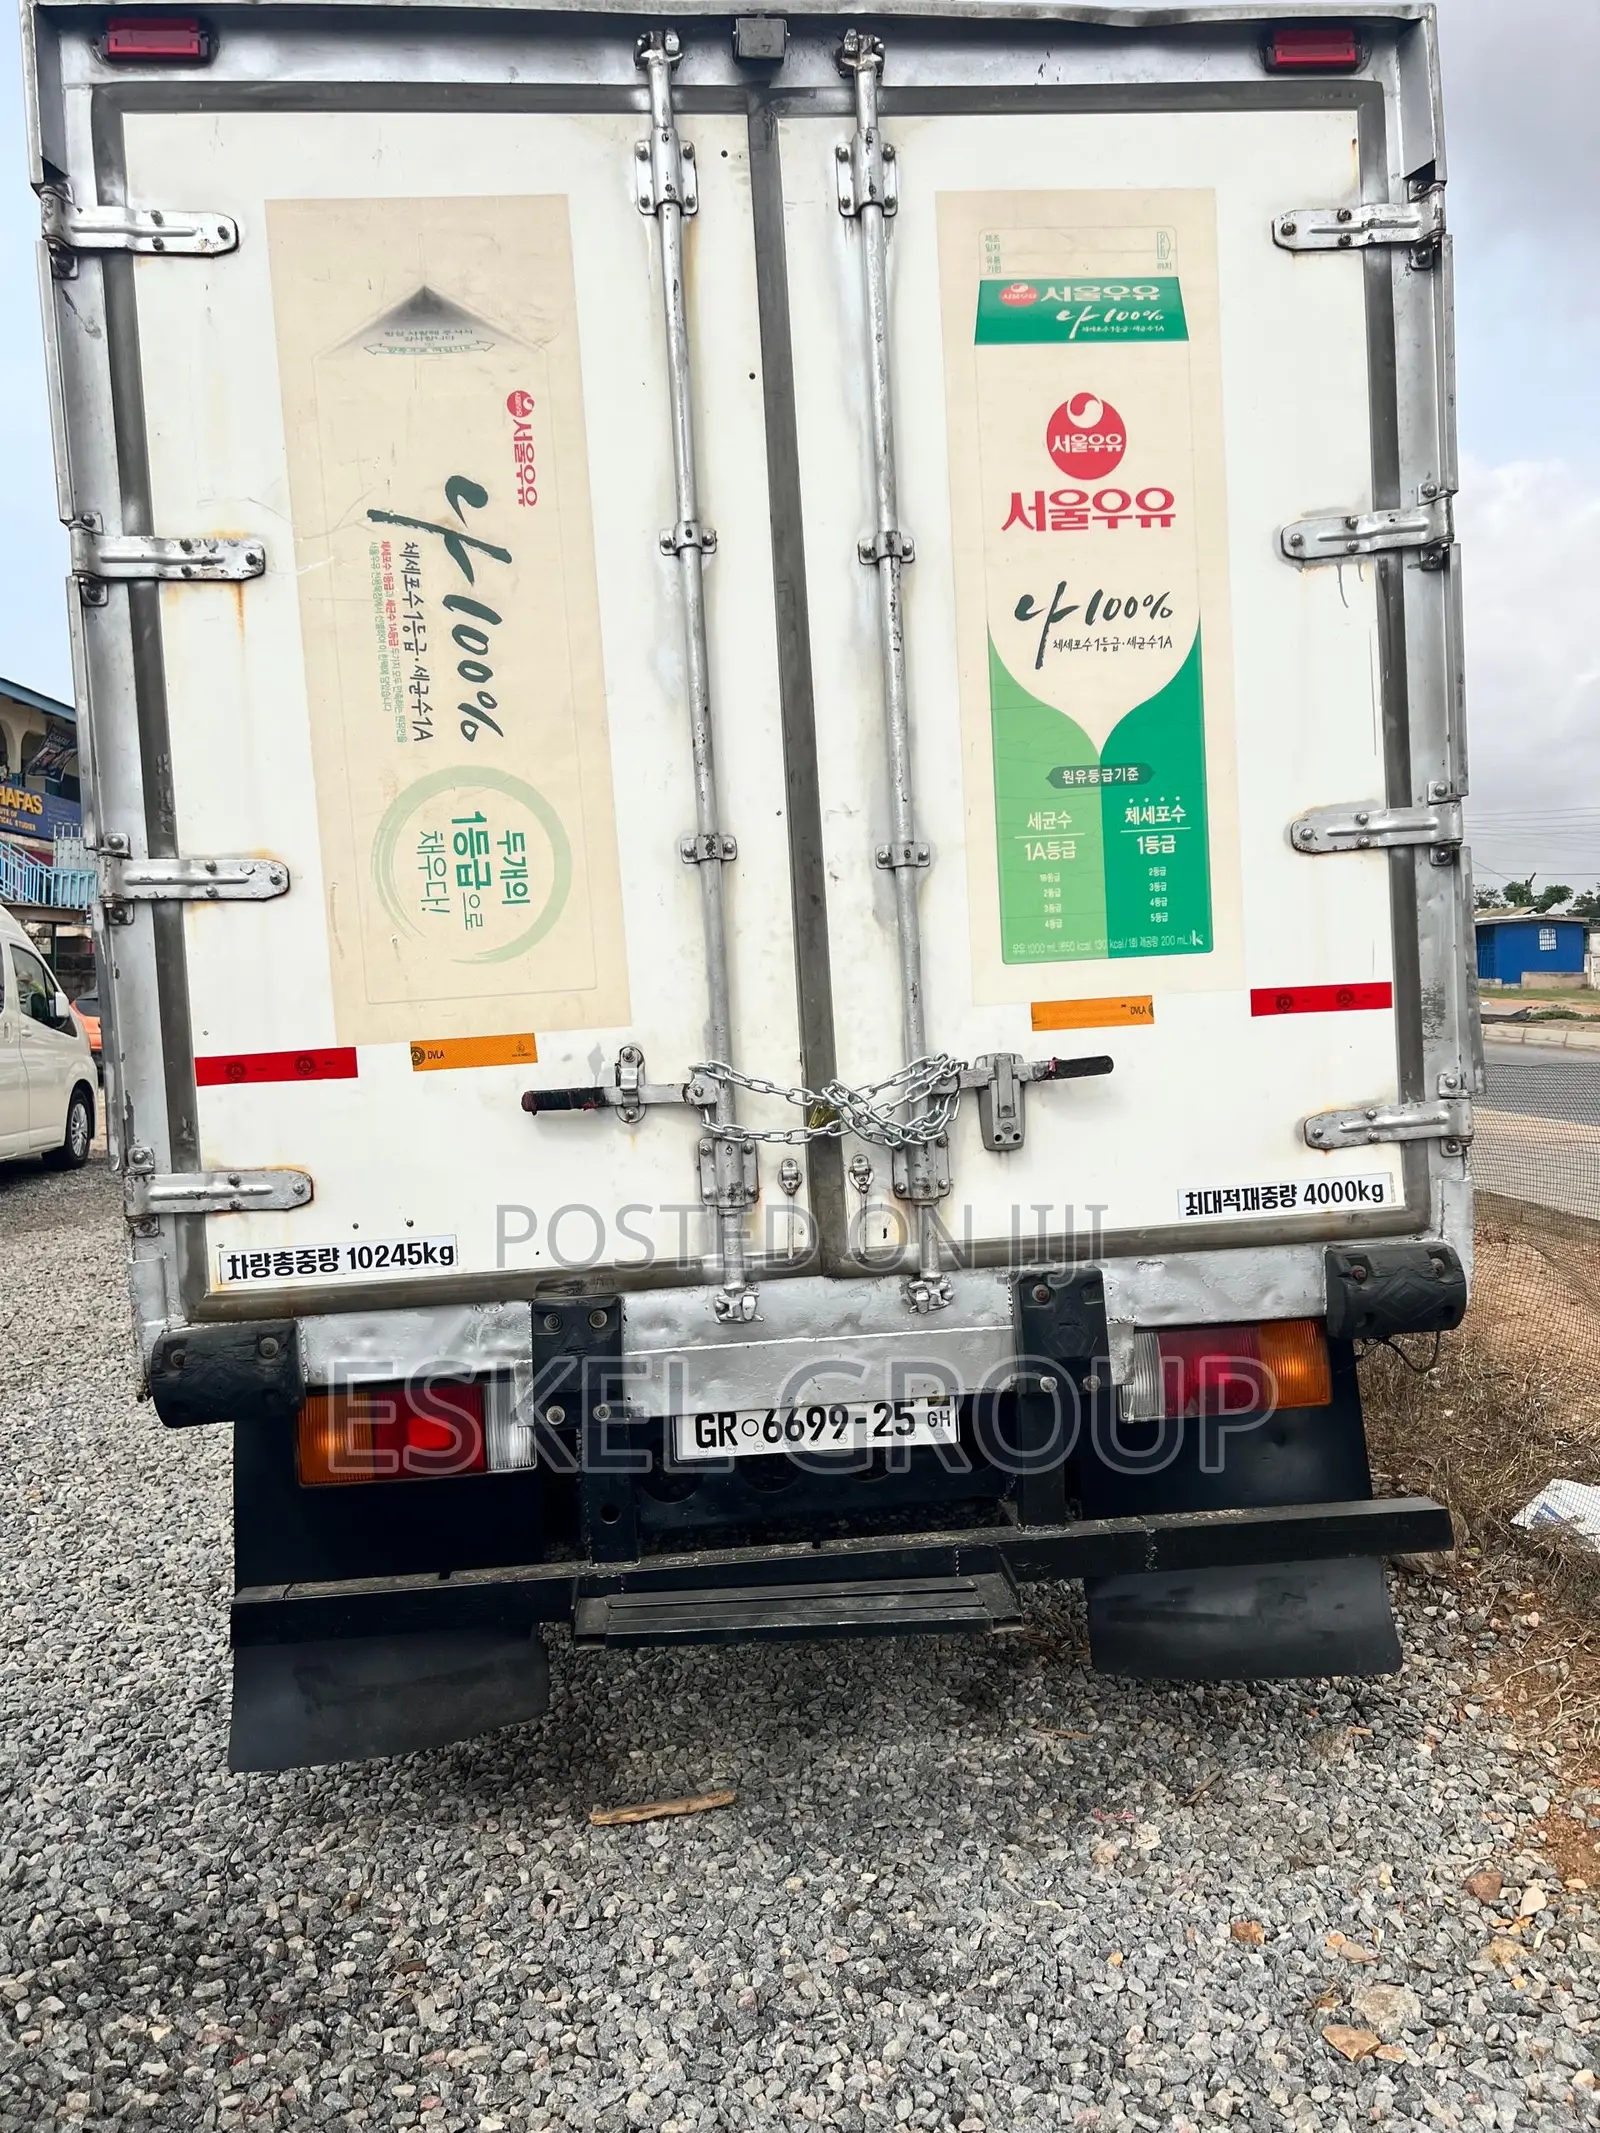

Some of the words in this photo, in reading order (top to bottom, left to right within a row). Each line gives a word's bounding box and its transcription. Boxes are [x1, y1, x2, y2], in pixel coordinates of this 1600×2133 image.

[1040, 285, 1160, 302] 서울우유
[1056, 305, 1101, 340] 나
[1103, 308, 1164, 323] 100%
[1051, 432, 1123, 453] 서울우유
[513, 418, 538, 507] 서울우유
[1001, 487, 1176, 532] 서울우유
[366, 475, 513, 586] 나
[442, 593, 504, 742] 100%
[1014, 580, 1082, 670] 나
[1084, 588, 1174, 626] 100%
[1062, 767, 1139, 784] 원유등급기준
[1027, 811, 1073, 831] 세균수
[1124, 804, 1186, 825] 체세포수
[1024, 840, 1076, 861] 1A등급
[1137, 834, 1176, 855] 1등급
[416, 831, 450, 913] 채우다!
[496, 830, 531, 905] 두개의
[1148, 866, 1167, 877] 2등급
[1149, 881, 1167, 892] 3등급
[1150, 896, 1168, 907] 4등급
[1150, 912, 1169, 923] 5등급
[1161, 935, 1176, 946] 200
[1130, 1005, 1147, 1015] DVLA
[427, 1050, 444, 1060] DVLA
[1185, 1184, 1297, 1216] 최대적재중량
[1303, 1180, 1384, 1205] 4000kg
[227, 1246, 340, 1281] 차량총중량
[346, 1242, 454, 1270] 10245kg
[695, 1411, 738, 1448] GR
[762, 1400, 916, 1444] 6699-25
[927, 1410, 950, 1428] GH
